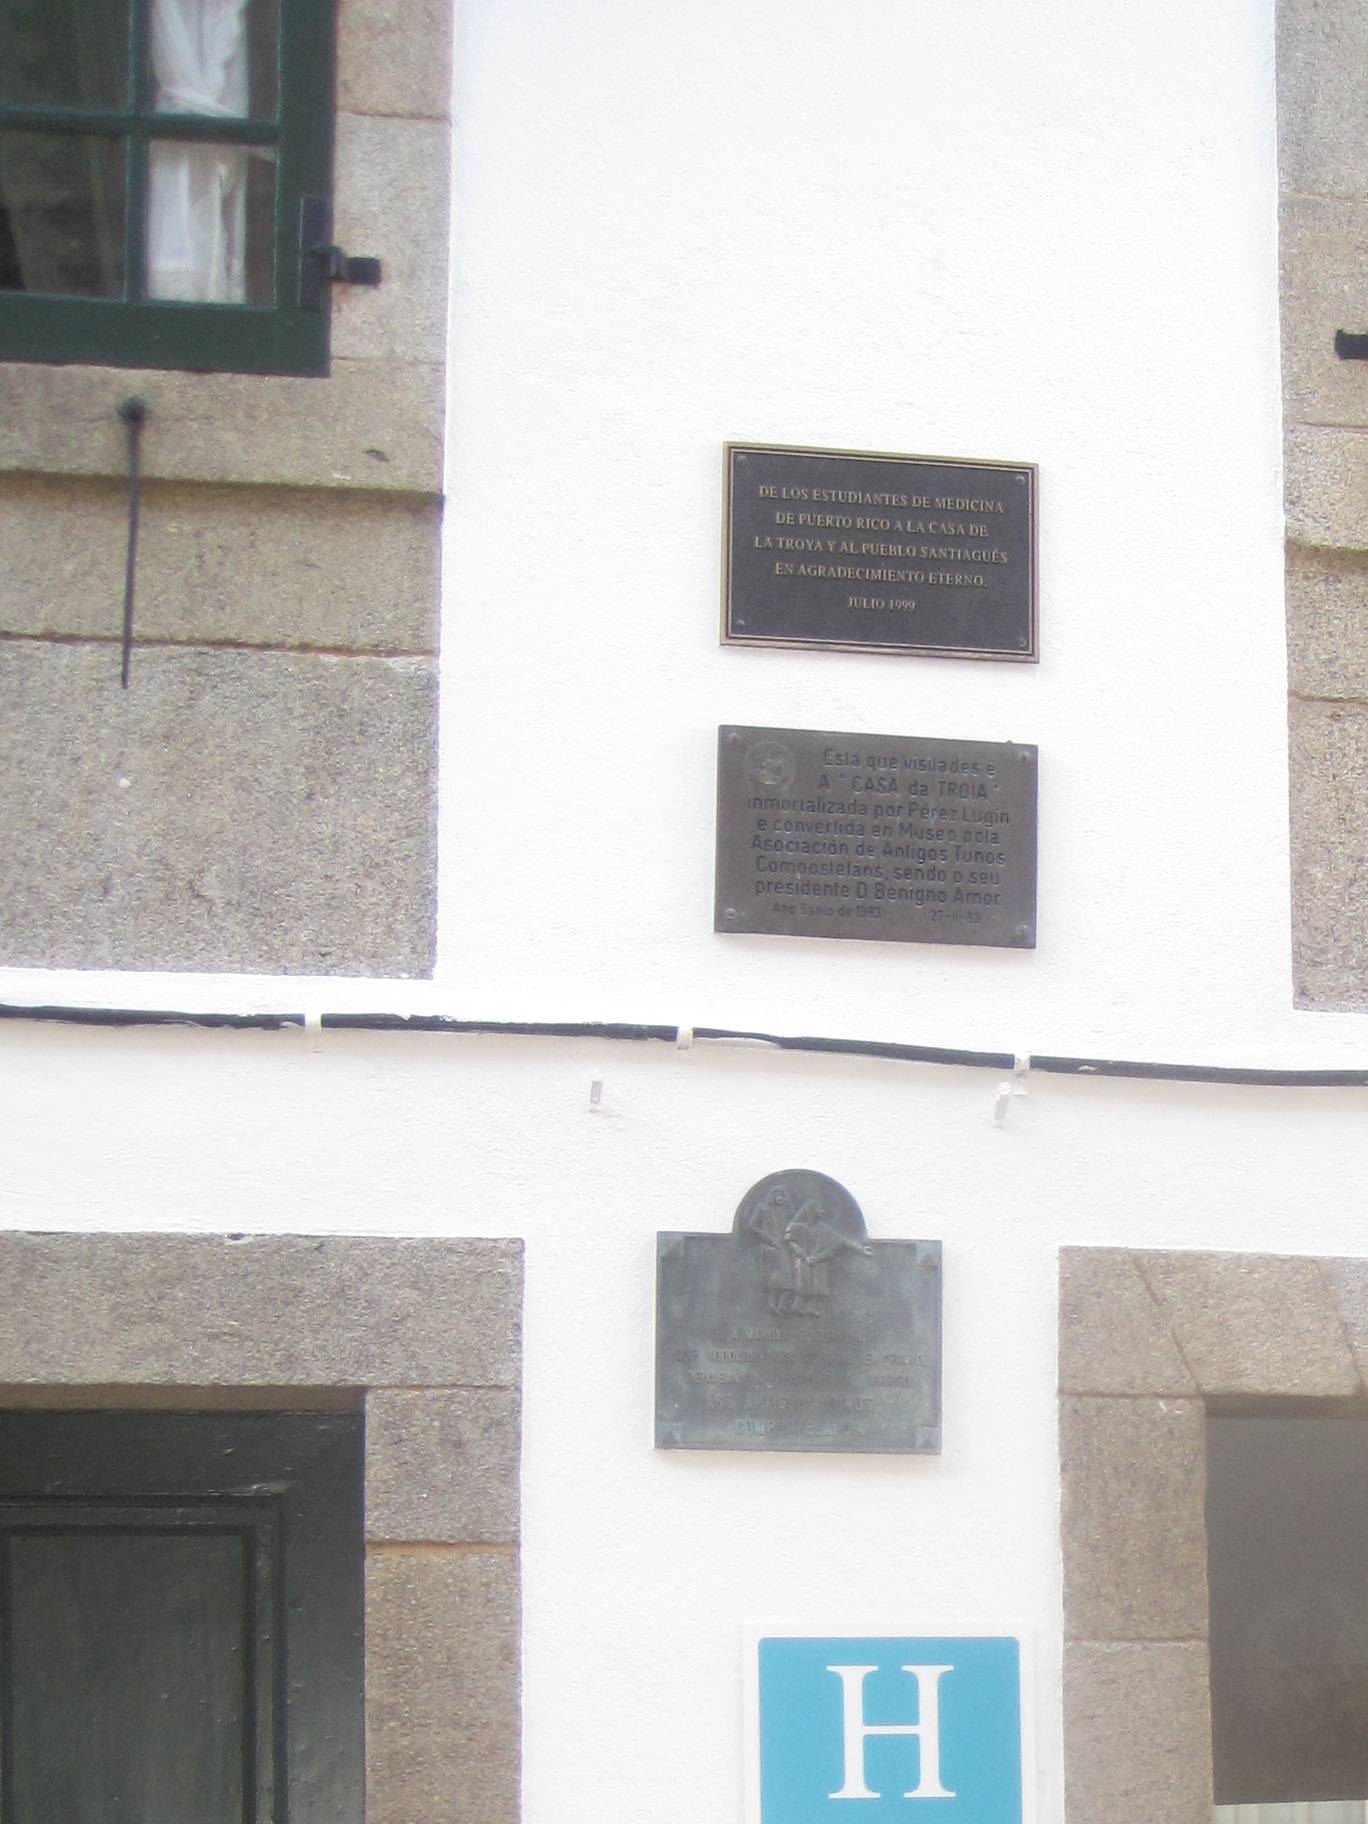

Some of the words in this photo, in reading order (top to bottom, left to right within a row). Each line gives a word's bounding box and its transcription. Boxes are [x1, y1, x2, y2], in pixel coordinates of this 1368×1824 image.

[759, 485, 778, 498] DE
[782, 486, 808, 500] LOS
[813, 489, 907, 506] ESTUDIANTES
[912, 496, 930, 508] DE
[935, 497, 1004, 513] MEDICINA
[776, 511, 795, 525] DE
[799, 513, 852, 528] PUERTO
[857, 517, 890, 530] RICO
[894, 520, 903, 531] A
[907, 521, 925, 533] LA
[929, 522, 965, 536] CASA
[970, 524, 988, 537] DE
[755, 536, 773, 549] LA
[777, 537, 823, 551] TROYA
[826, 540, 836, 552] Y
[840, 542, 859, 554] AL
[862, 542, 916, 557] PUEBLO
[920, 546, 1008, 564] SANTIAGUÉS
[775, 562, 794, 575] EN
[798, 564, 924, 583] AGRADECIMIENTO
[928, 572, 988, 588] ETERNO.
[848, 596, 885, 609] JULIO
[890, 599, 916, 612] 1999
[823, 748, 860, 767] Esta
[866, 755, 897, 771] que
[908, 779, 928, 797] da
[747, 796, 867, 815] inmortalizada
[873, 803, 902, 819] por
[757, 819, 767, 831] e
[773, 819, 865, 837] convertida
[872, 826, 893, 838] en
[899, 822, 957, 842] Museo
[855, 841, 875, 857] de
[952, 845, 1006, 865] Tunos
[893, 866, 946, 883] sendo
[969, 871, 1000, 886] seu
[755, 880, 849, 897] presidente
[874, 882, 947, 907] Benigno
[826, 1665, 956, 1799] H
